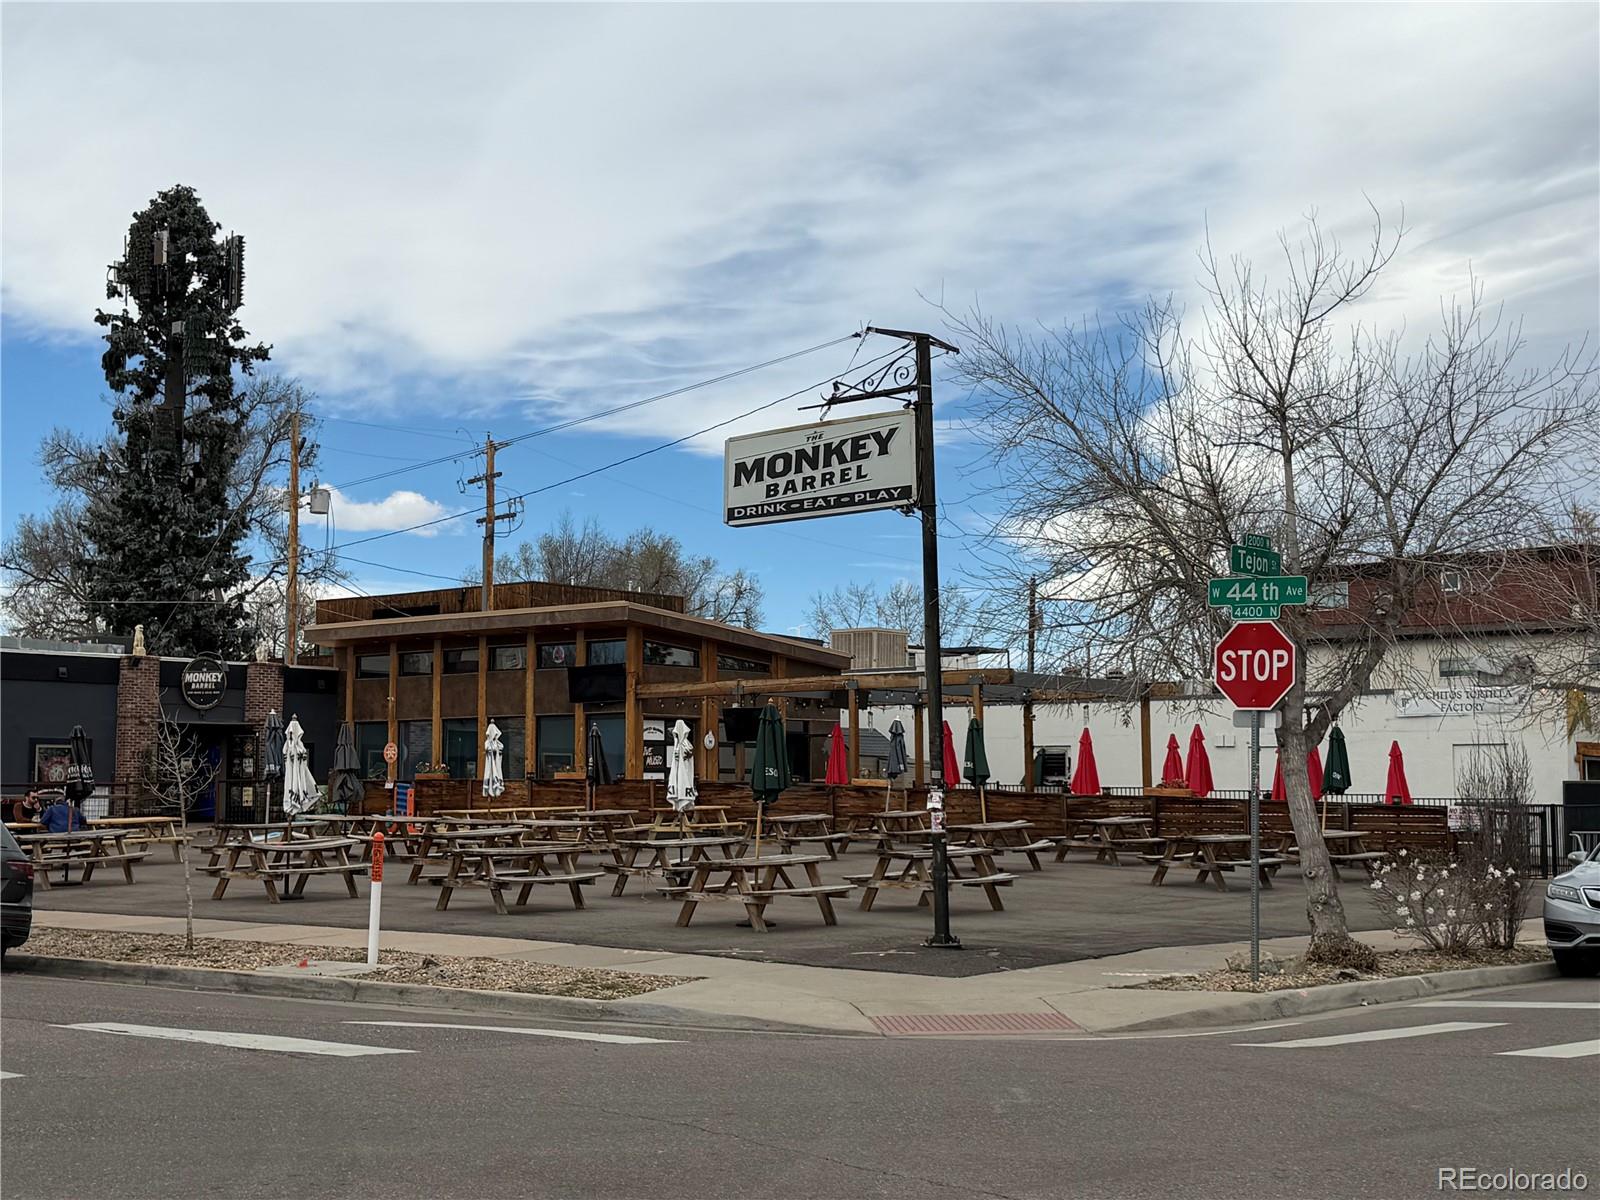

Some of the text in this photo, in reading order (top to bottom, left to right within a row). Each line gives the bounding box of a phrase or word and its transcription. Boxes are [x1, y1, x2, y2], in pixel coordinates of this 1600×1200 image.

[806, 433, 824, 443] THE
[733, 426, 899, 489] MONKEY
[765, 464, 869, 499] BARREL
[734, 487, 902, 518] DRINK EAT PLAY
[1237, 549, 1269, 573] Tejon
[1212, 582, 1303, 602] W 44th Ave
[1234, 605, 1278, 617] 4400 N
[1220, 649, 1289, 682] STOP
[184, 672, 223, 683] MONKEY
[1440, 702, 1485, 713] FACTORY
